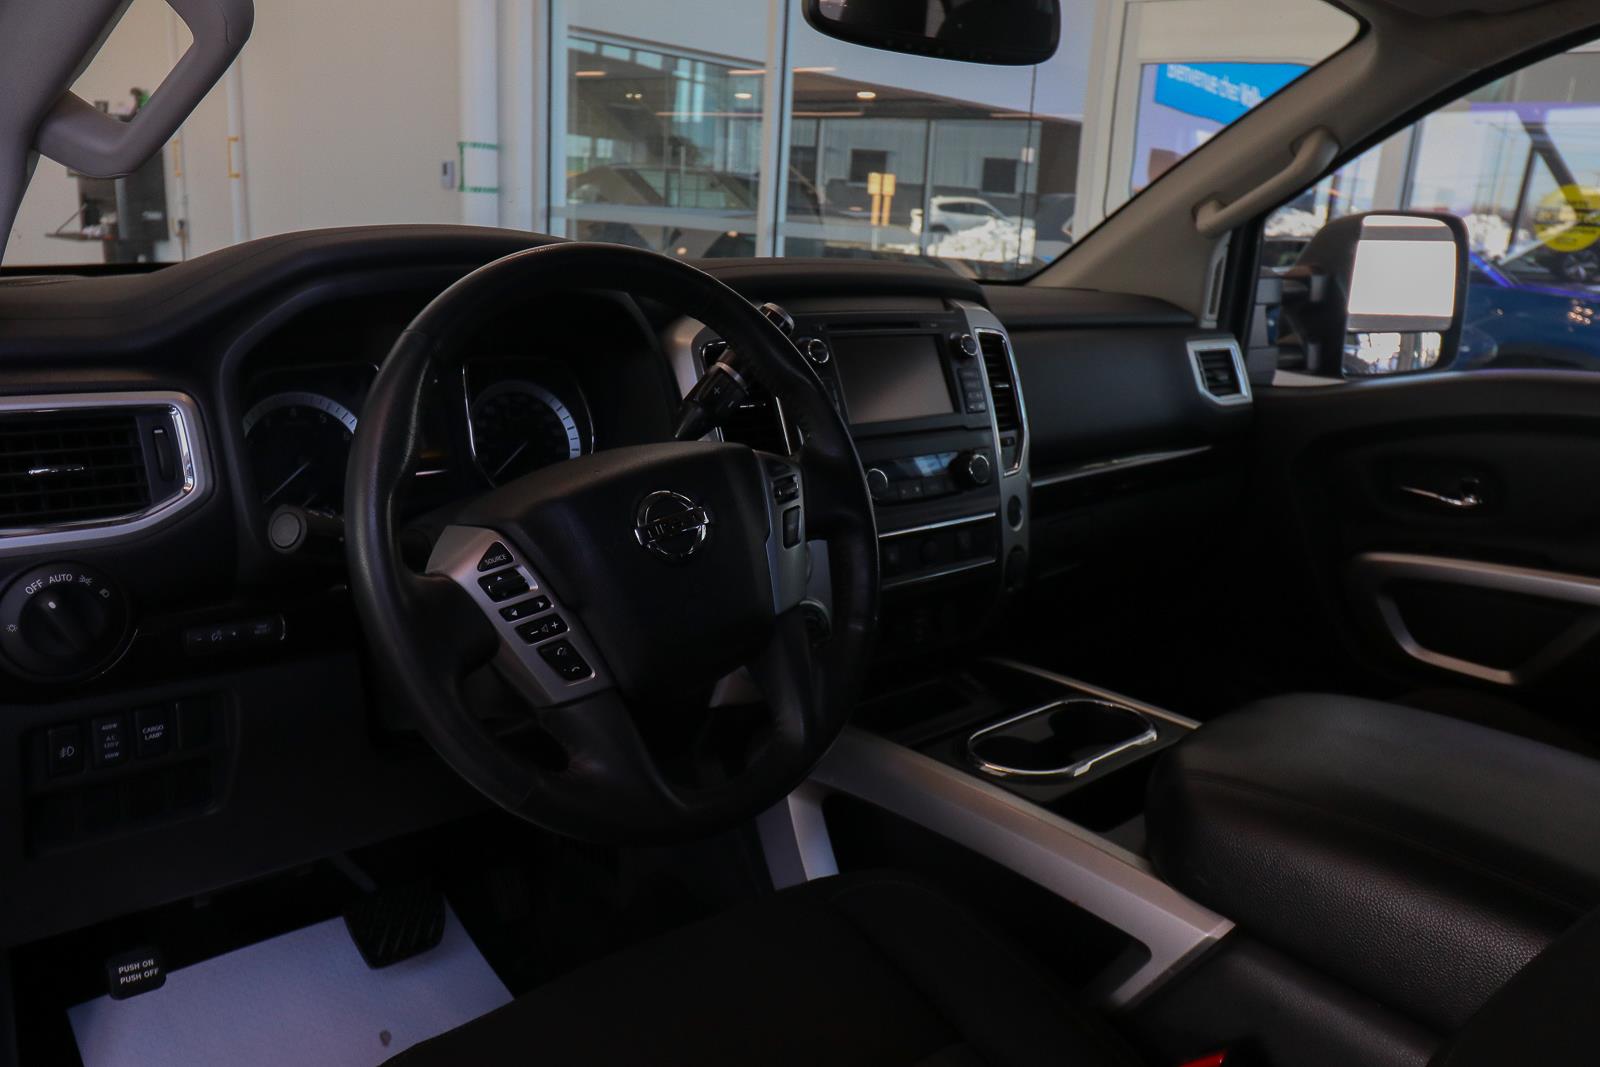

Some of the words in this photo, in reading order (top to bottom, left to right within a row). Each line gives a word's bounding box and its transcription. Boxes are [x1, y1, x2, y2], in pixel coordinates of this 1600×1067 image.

[485, 553, 508, 565] SOURCE
[25, 579, 43, 595] OFF
[49, 573, 73, 584] AUTO
[142, 724, 164, 734] CARGO
[145, 732, 163, 741] LAMP
[118, 962, 140, 974] PUSH
[142, 959, 154, 968] ON
[120, 973, 142, 984] PUSH
[144, 968, 159, 978] OFF
